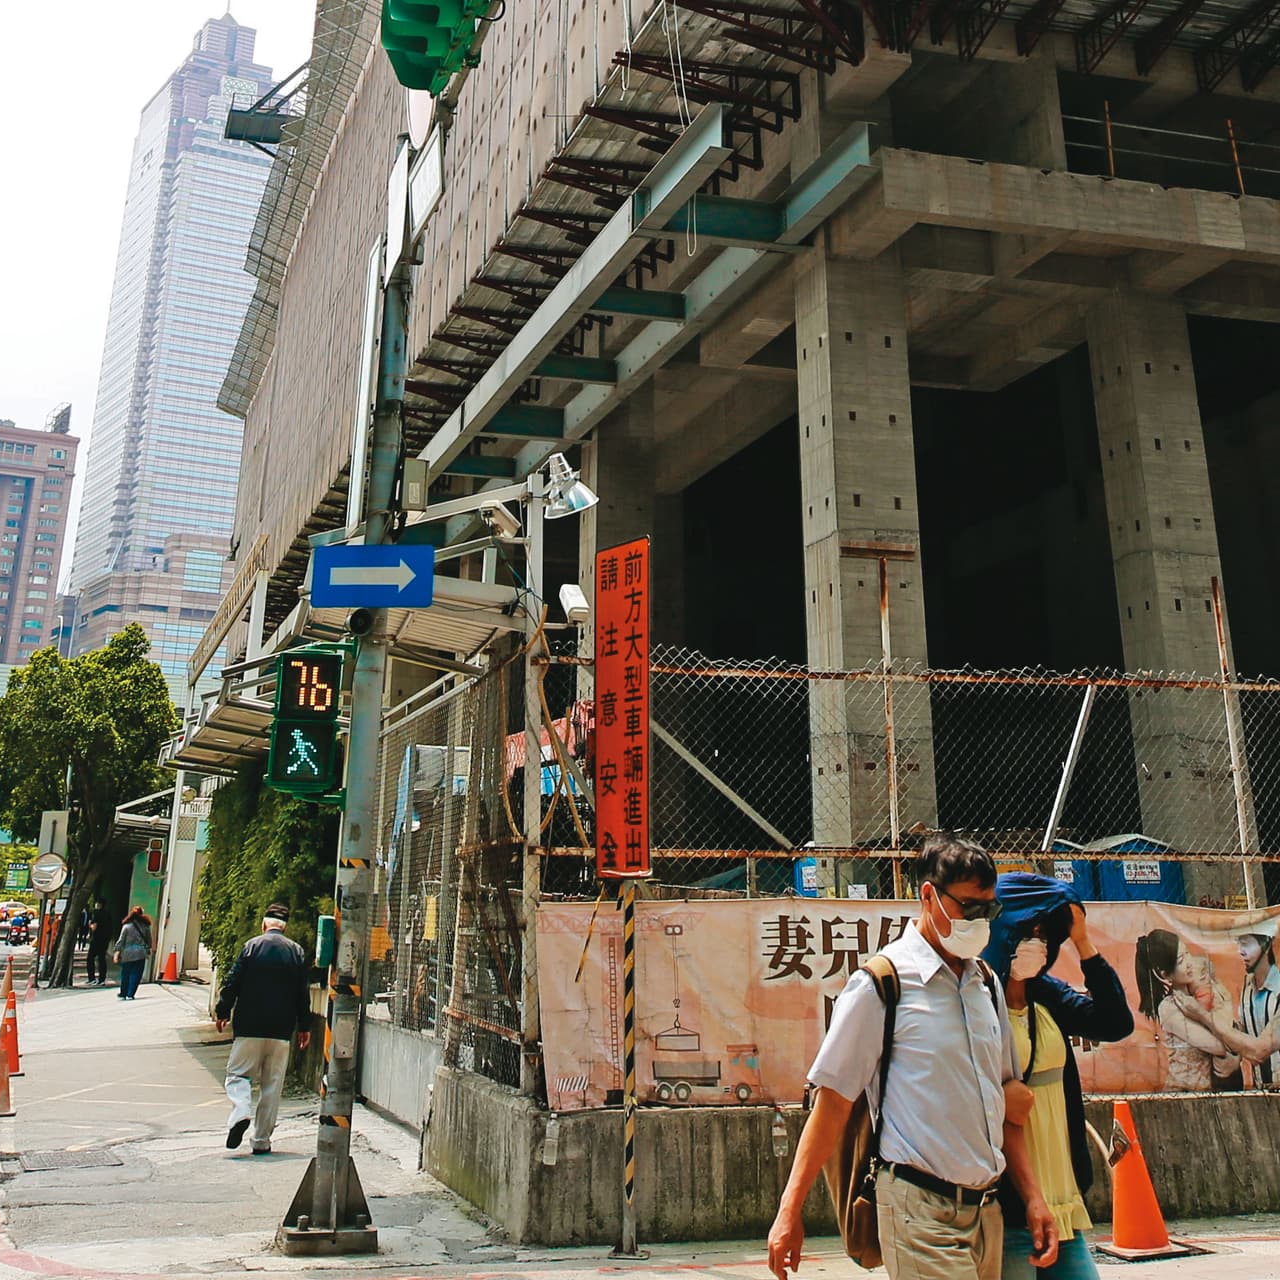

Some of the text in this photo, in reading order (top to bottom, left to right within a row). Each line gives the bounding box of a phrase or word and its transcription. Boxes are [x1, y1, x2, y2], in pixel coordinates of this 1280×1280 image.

[290, 660, 332, 711] 76
[600, 557, 619, 867] 請注意安全
[624, 551, 644, 867] 前方大型車輛進出
